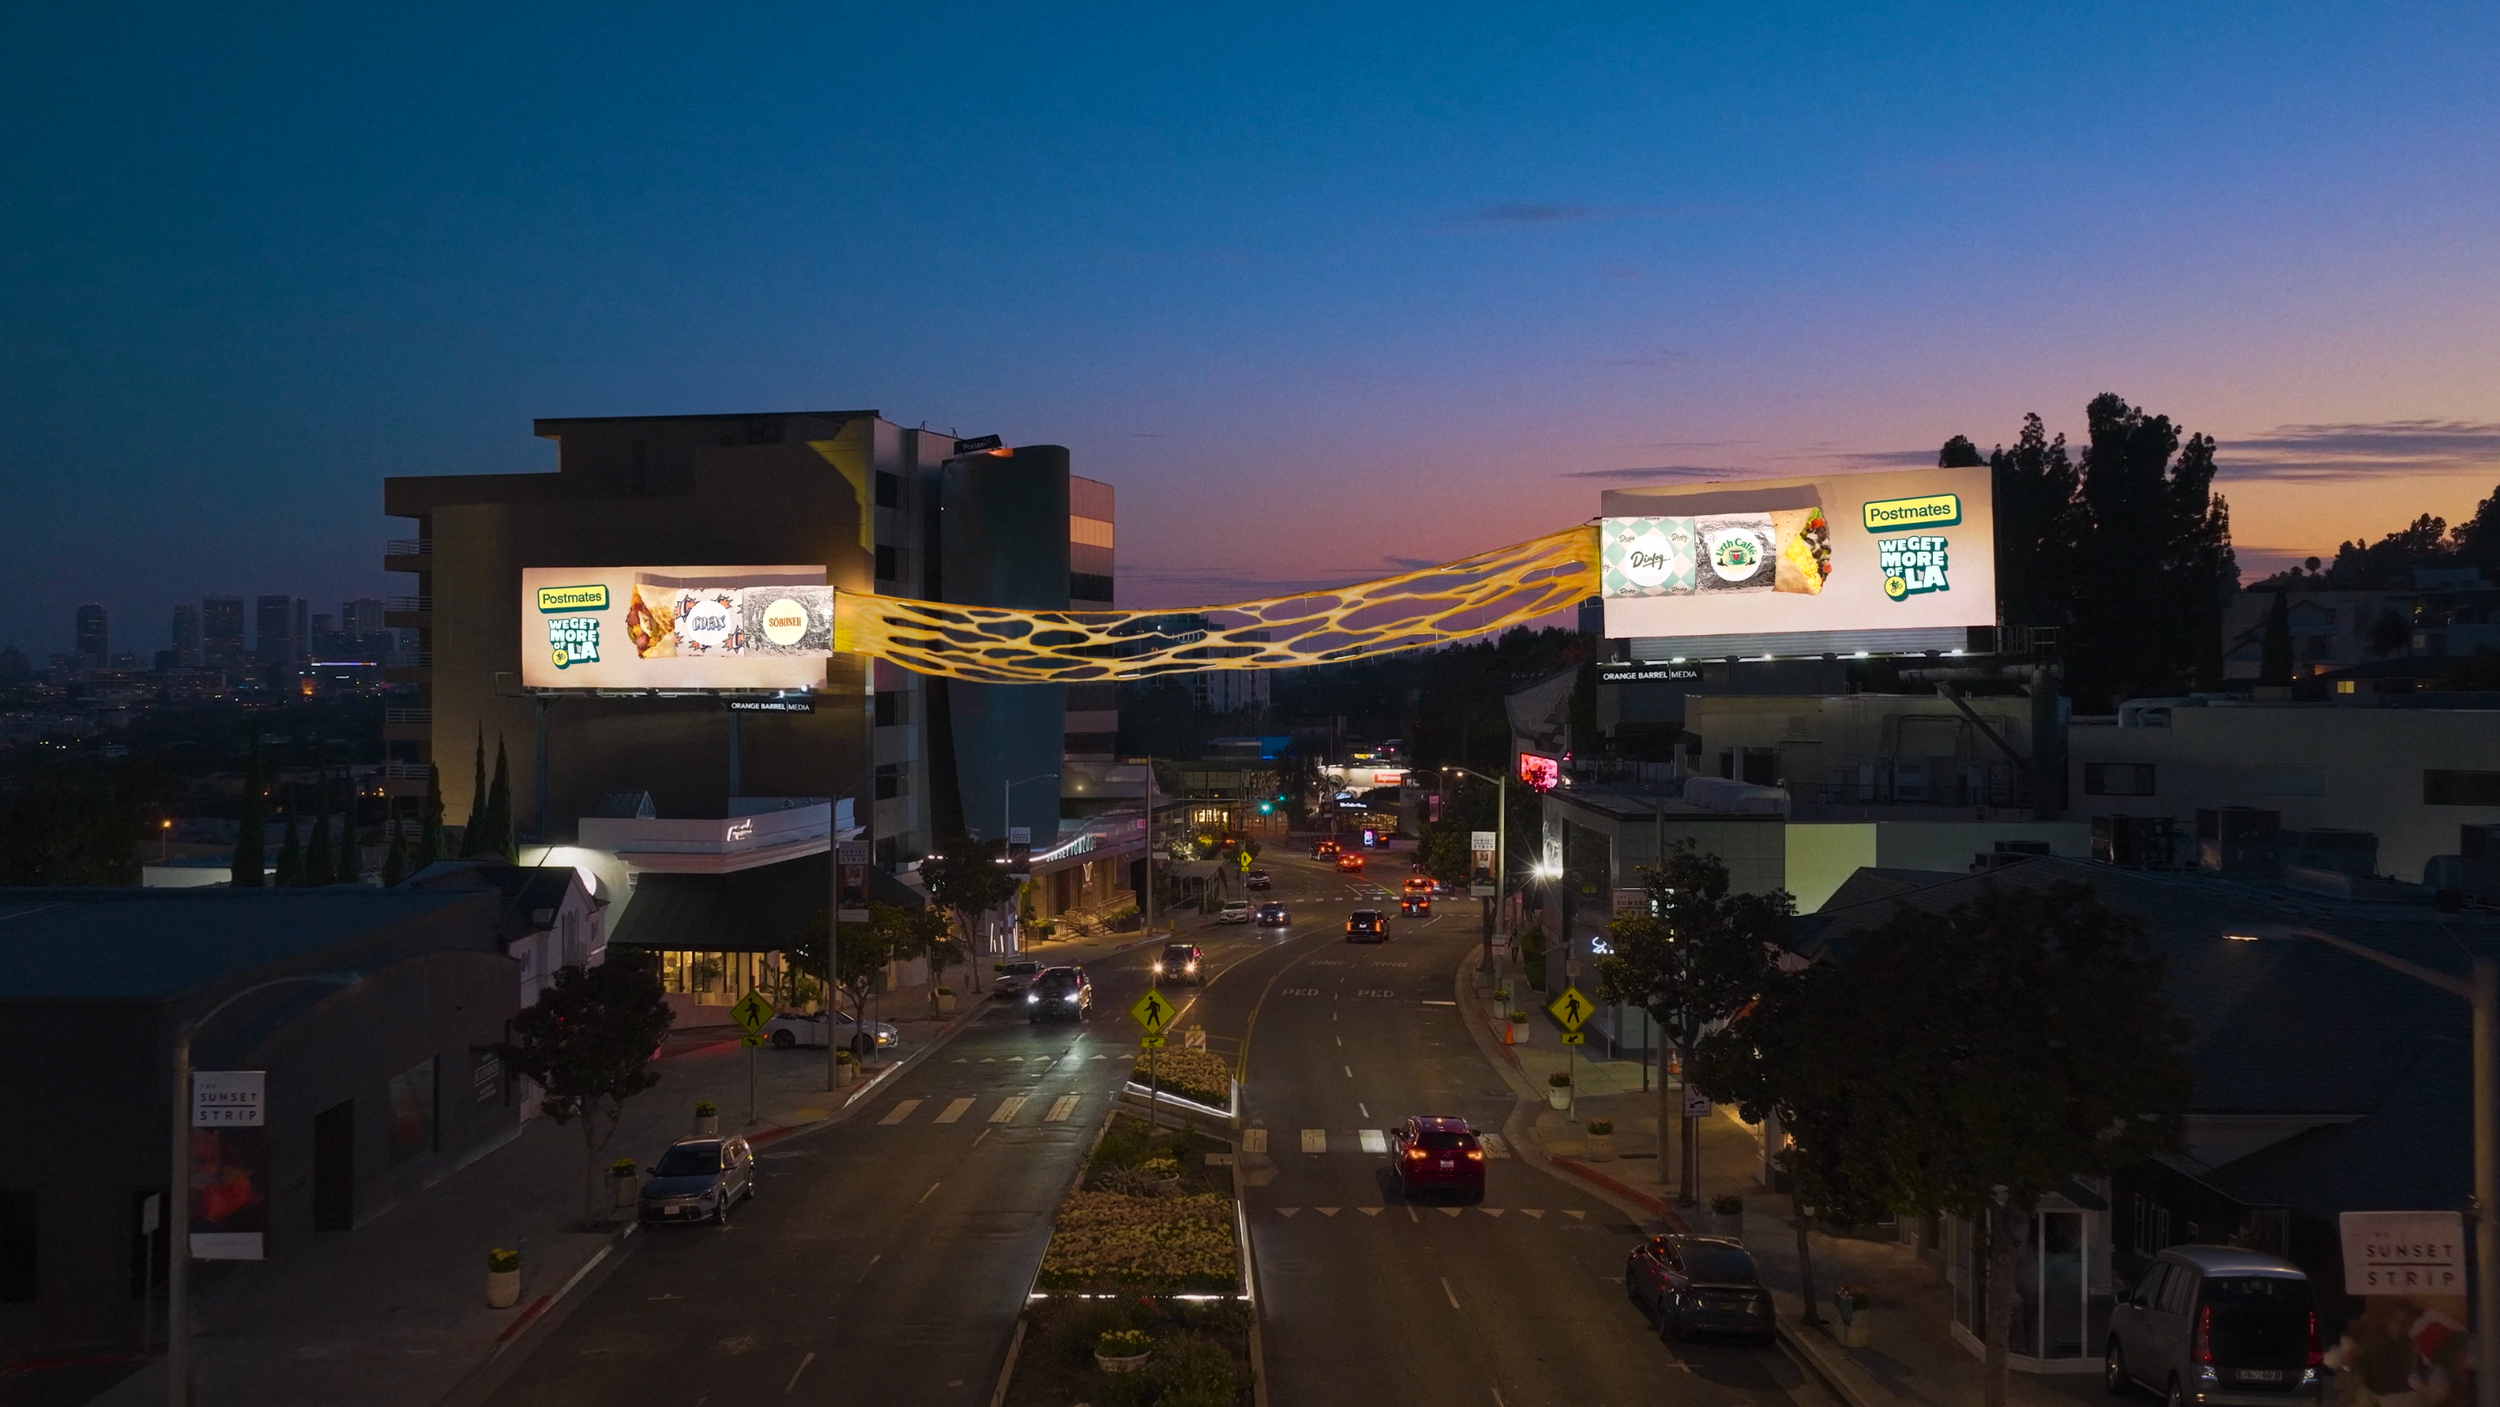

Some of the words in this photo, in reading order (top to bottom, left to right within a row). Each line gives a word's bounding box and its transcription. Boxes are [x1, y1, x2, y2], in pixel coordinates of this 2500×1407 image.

[1870, 504, 1951, 522] Postmates
[1715, 540, 1734, 556] Urth
[1734, 537, 1758, 556] Caffé
[1881, 551, 1945, 567] MORE
[1886, 567, 1903, 577] OF
[1905, 565, 1946, 590] LA
[543, 592, 602, 604] Postmates
[550, 629, 597, 642] MORE
[553, 642, 566, 650] OF
[567, 641, 598, 660] LA
[1603, 672, 1637, 680] ORANGE
[1638, 671, 1668, 679] BARREL
[1671, 670, 1698, 679] MEDIA
[731, 702, 760, 710] ORANGE
[760, 702, 786, 710] BARREL
[788, 703, 810, 711] MEDIA
[1282, 988, 1319, 996] PED
[1358, 989, 1394, 998] PED
[200, 1093, 257, 1102] SUNSET
[200, 1110, 257, 1121] STRIP
[2366, 1244, 2453, 1258] SUNSET
[2367, 1271, 2454, 1287] STRIP
